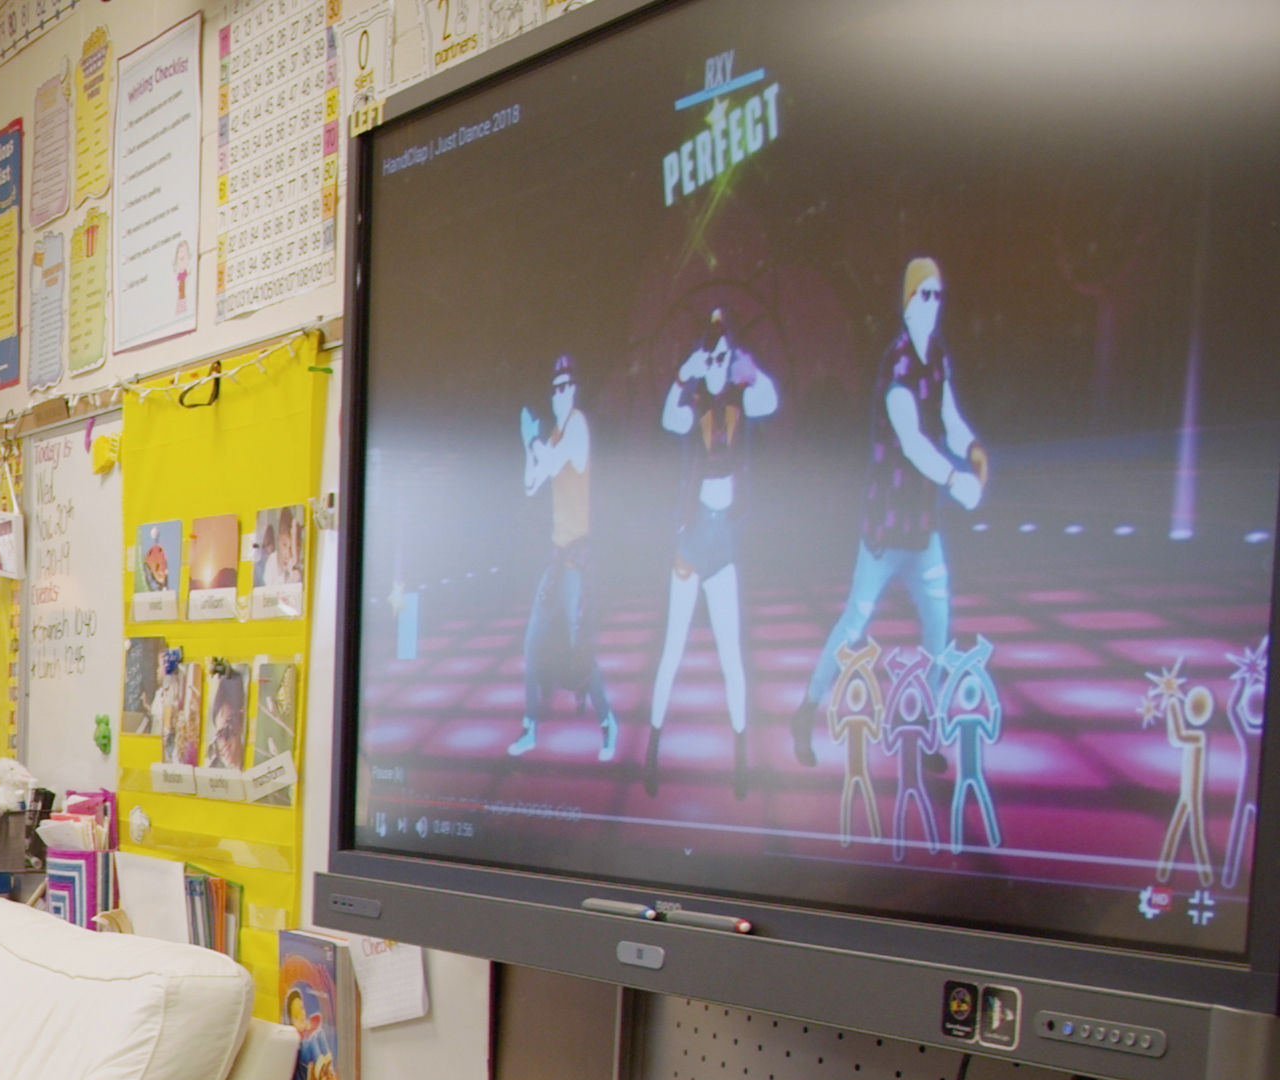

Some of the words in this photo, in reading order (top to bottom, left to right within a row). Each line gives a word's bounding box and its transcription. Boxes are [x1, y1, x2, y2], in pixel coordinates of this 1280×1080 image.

[8, 12, 17, 37] 80
[358, 29, 370, 71] 0
[434, 33, 478, 67] partners
[128, 74, 153, 104] Writing
[155, 56, 189, 83] Checklist
[382, 144, 428, 177] HandClap
[435, 131, 458, 156] Just
[458, 119, 490, 147] Dance
[492, 103, 521, 133] 2018
[662, 81, 780, 208] PERFECT
[34, 440, 60, 470] Today
[31, 582, 59, 606] Events
[1151, 893, 1169, 906] HD
